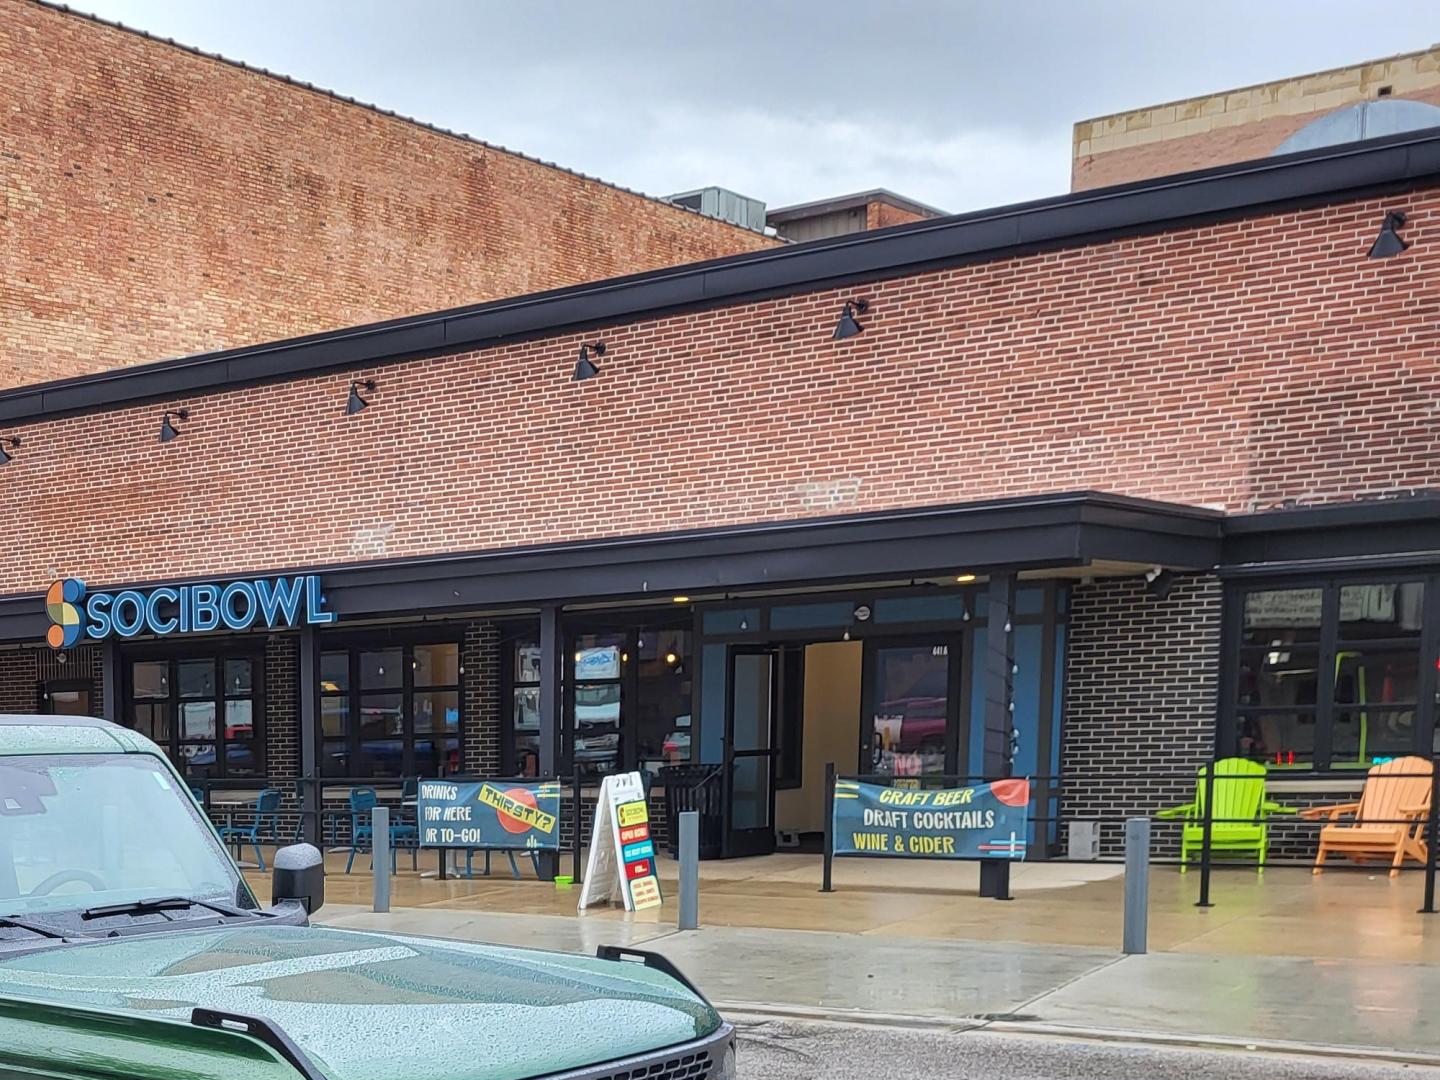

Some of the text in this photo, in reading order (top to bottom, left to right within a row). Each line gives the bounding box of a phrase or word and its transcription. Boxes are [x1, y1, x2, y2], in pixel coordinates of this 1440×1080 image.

[86, 576, 337, 640] SOCIBOWL
[421, 785, 458, 801] DRINKS
[879, 788, 975, 806] CRAFT BEER
[424, 806, 472, 821] FOR HERE
[484, 788, 552, 829] THIRSTY?
[863, 808, 995, 829] DRAFT COCKTAILS
[425, 828, 481, 844] OR TO-GO!
[852, 832, 955, 854] WINE & CIDER
